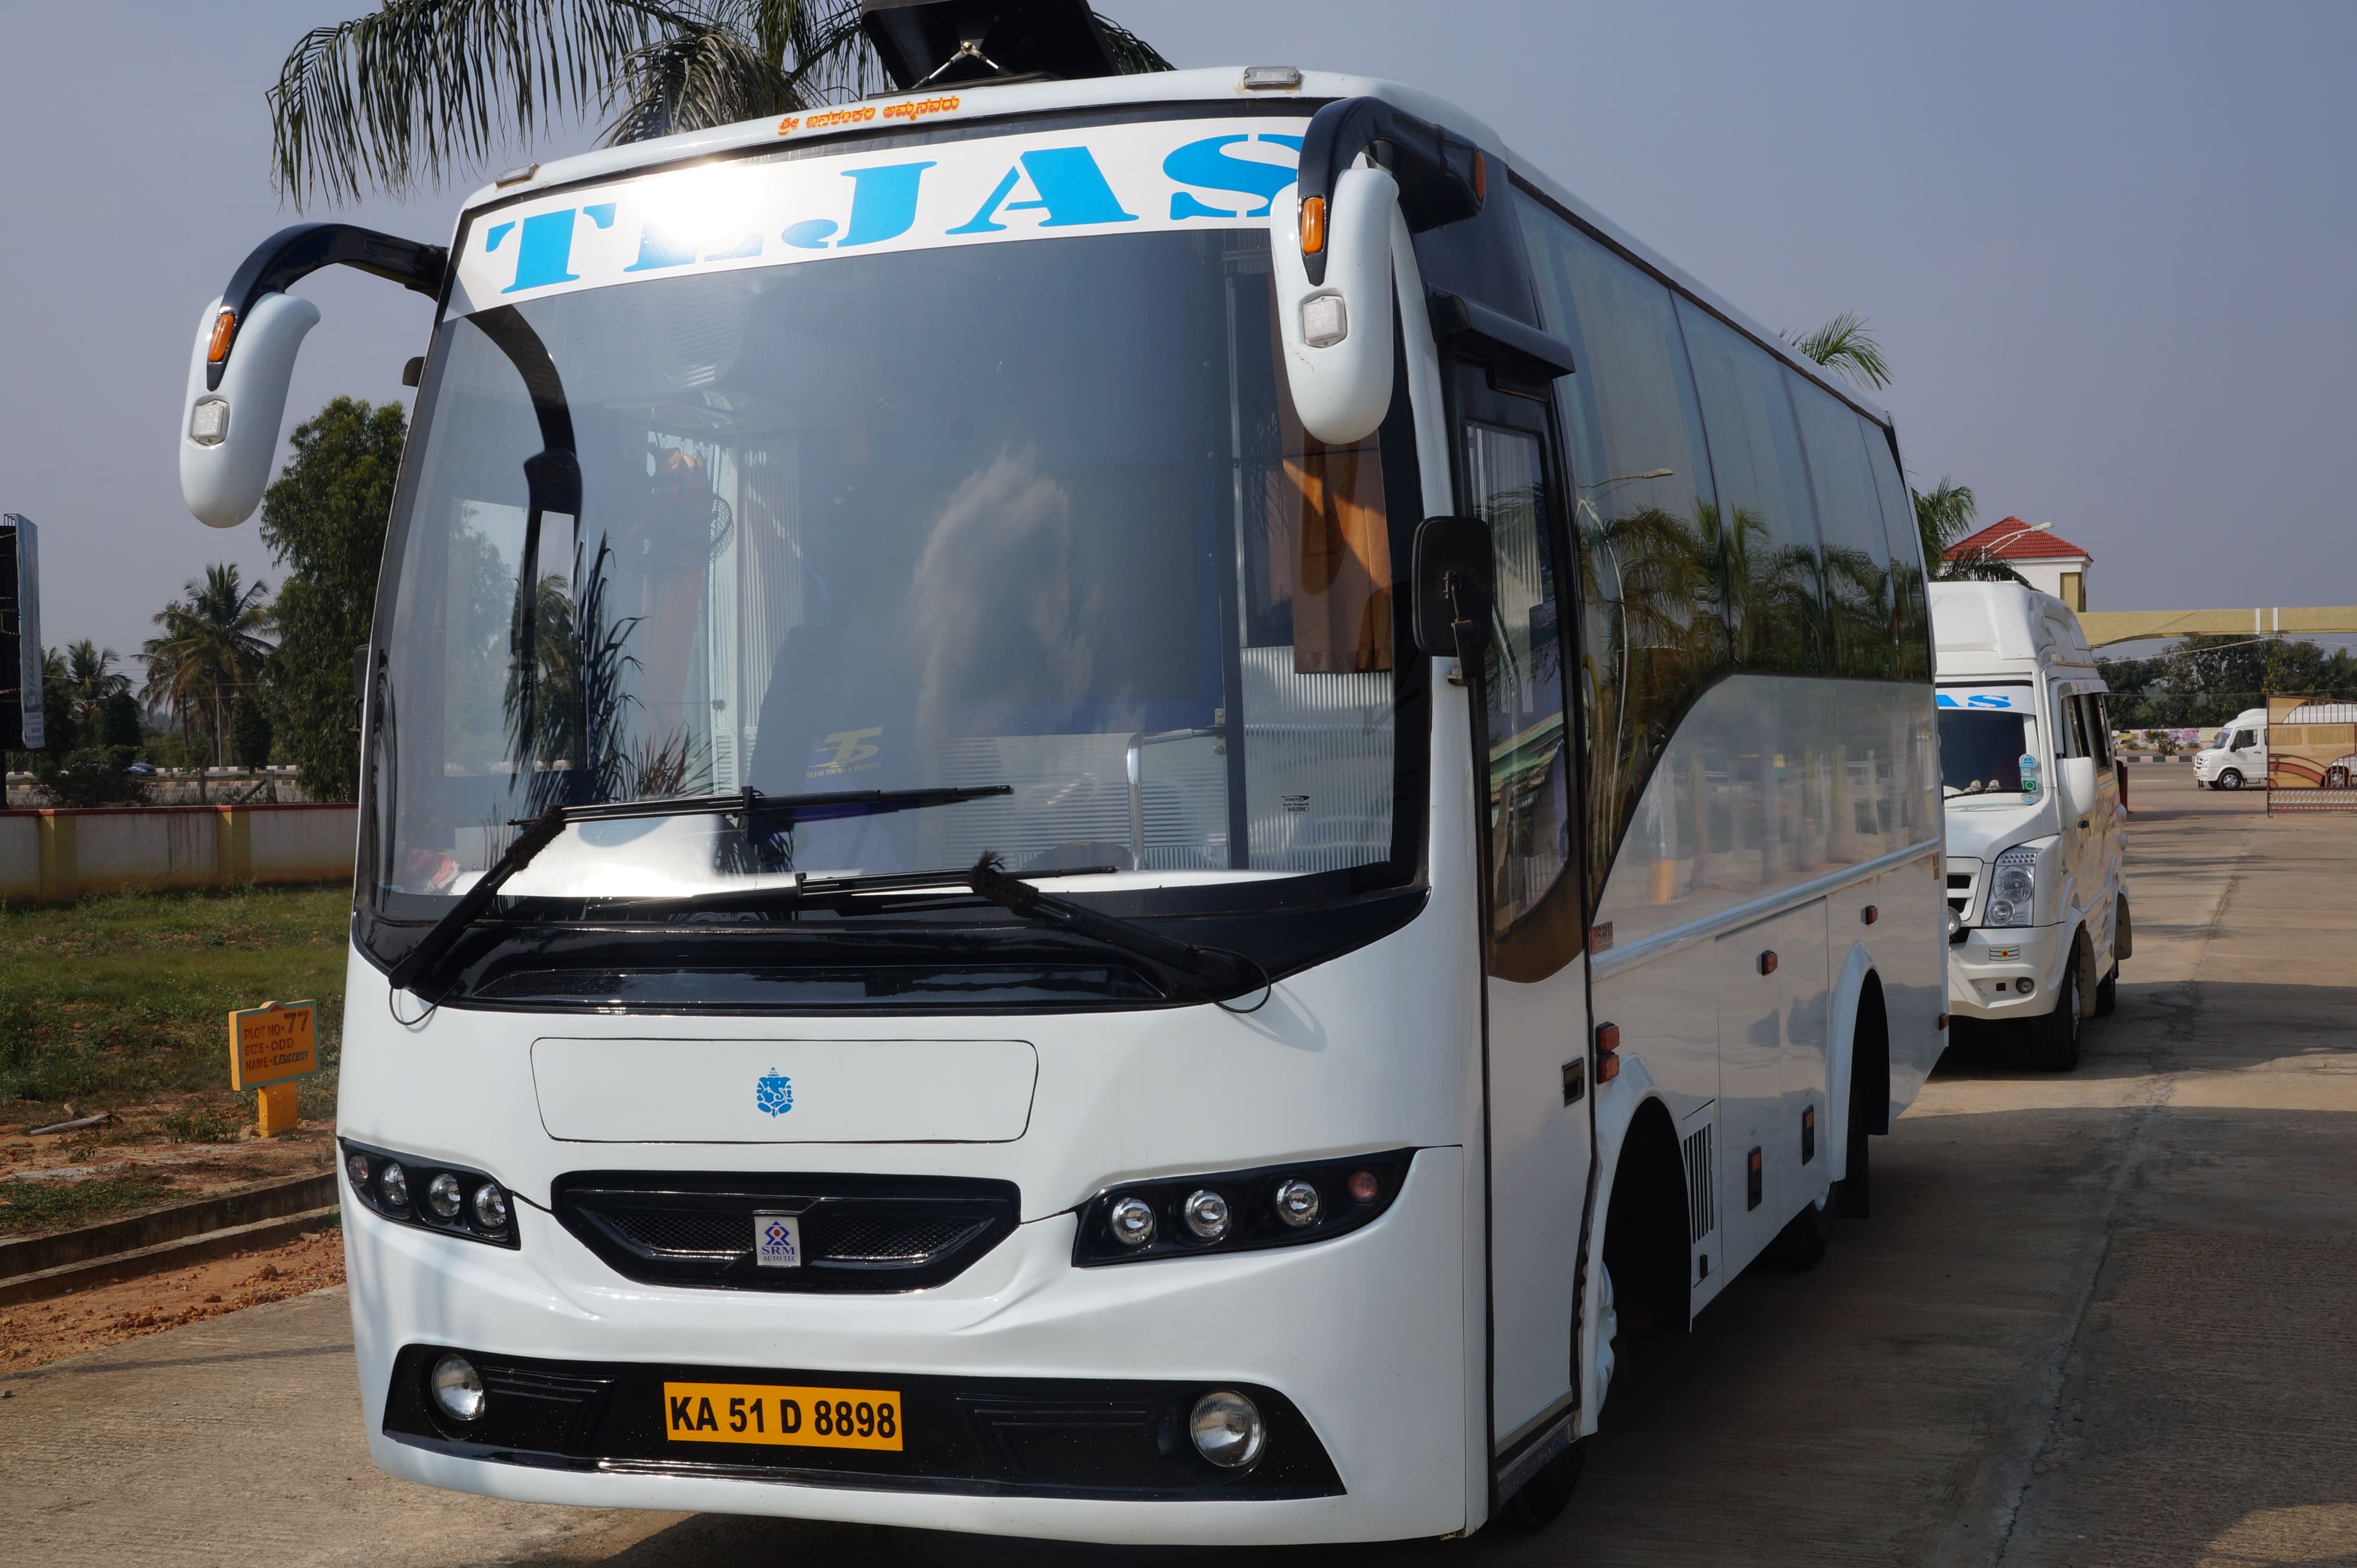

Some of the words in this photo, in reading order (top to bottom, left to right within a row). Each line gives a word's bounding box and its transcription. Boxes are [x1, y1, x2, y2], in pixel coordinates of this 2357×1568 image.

[778, 116, 800, 136] ಶ್ರೀ
[243, 1025, 266, 1040] PLOT
[762, 1246, 795, 1255] SRM
[670, 1396, 719, 1432] KA
[729, 1398, 765, 1433] 51
[779, 1399, 802, 1434] D
[814, 1399, 896, 1439] 8898
